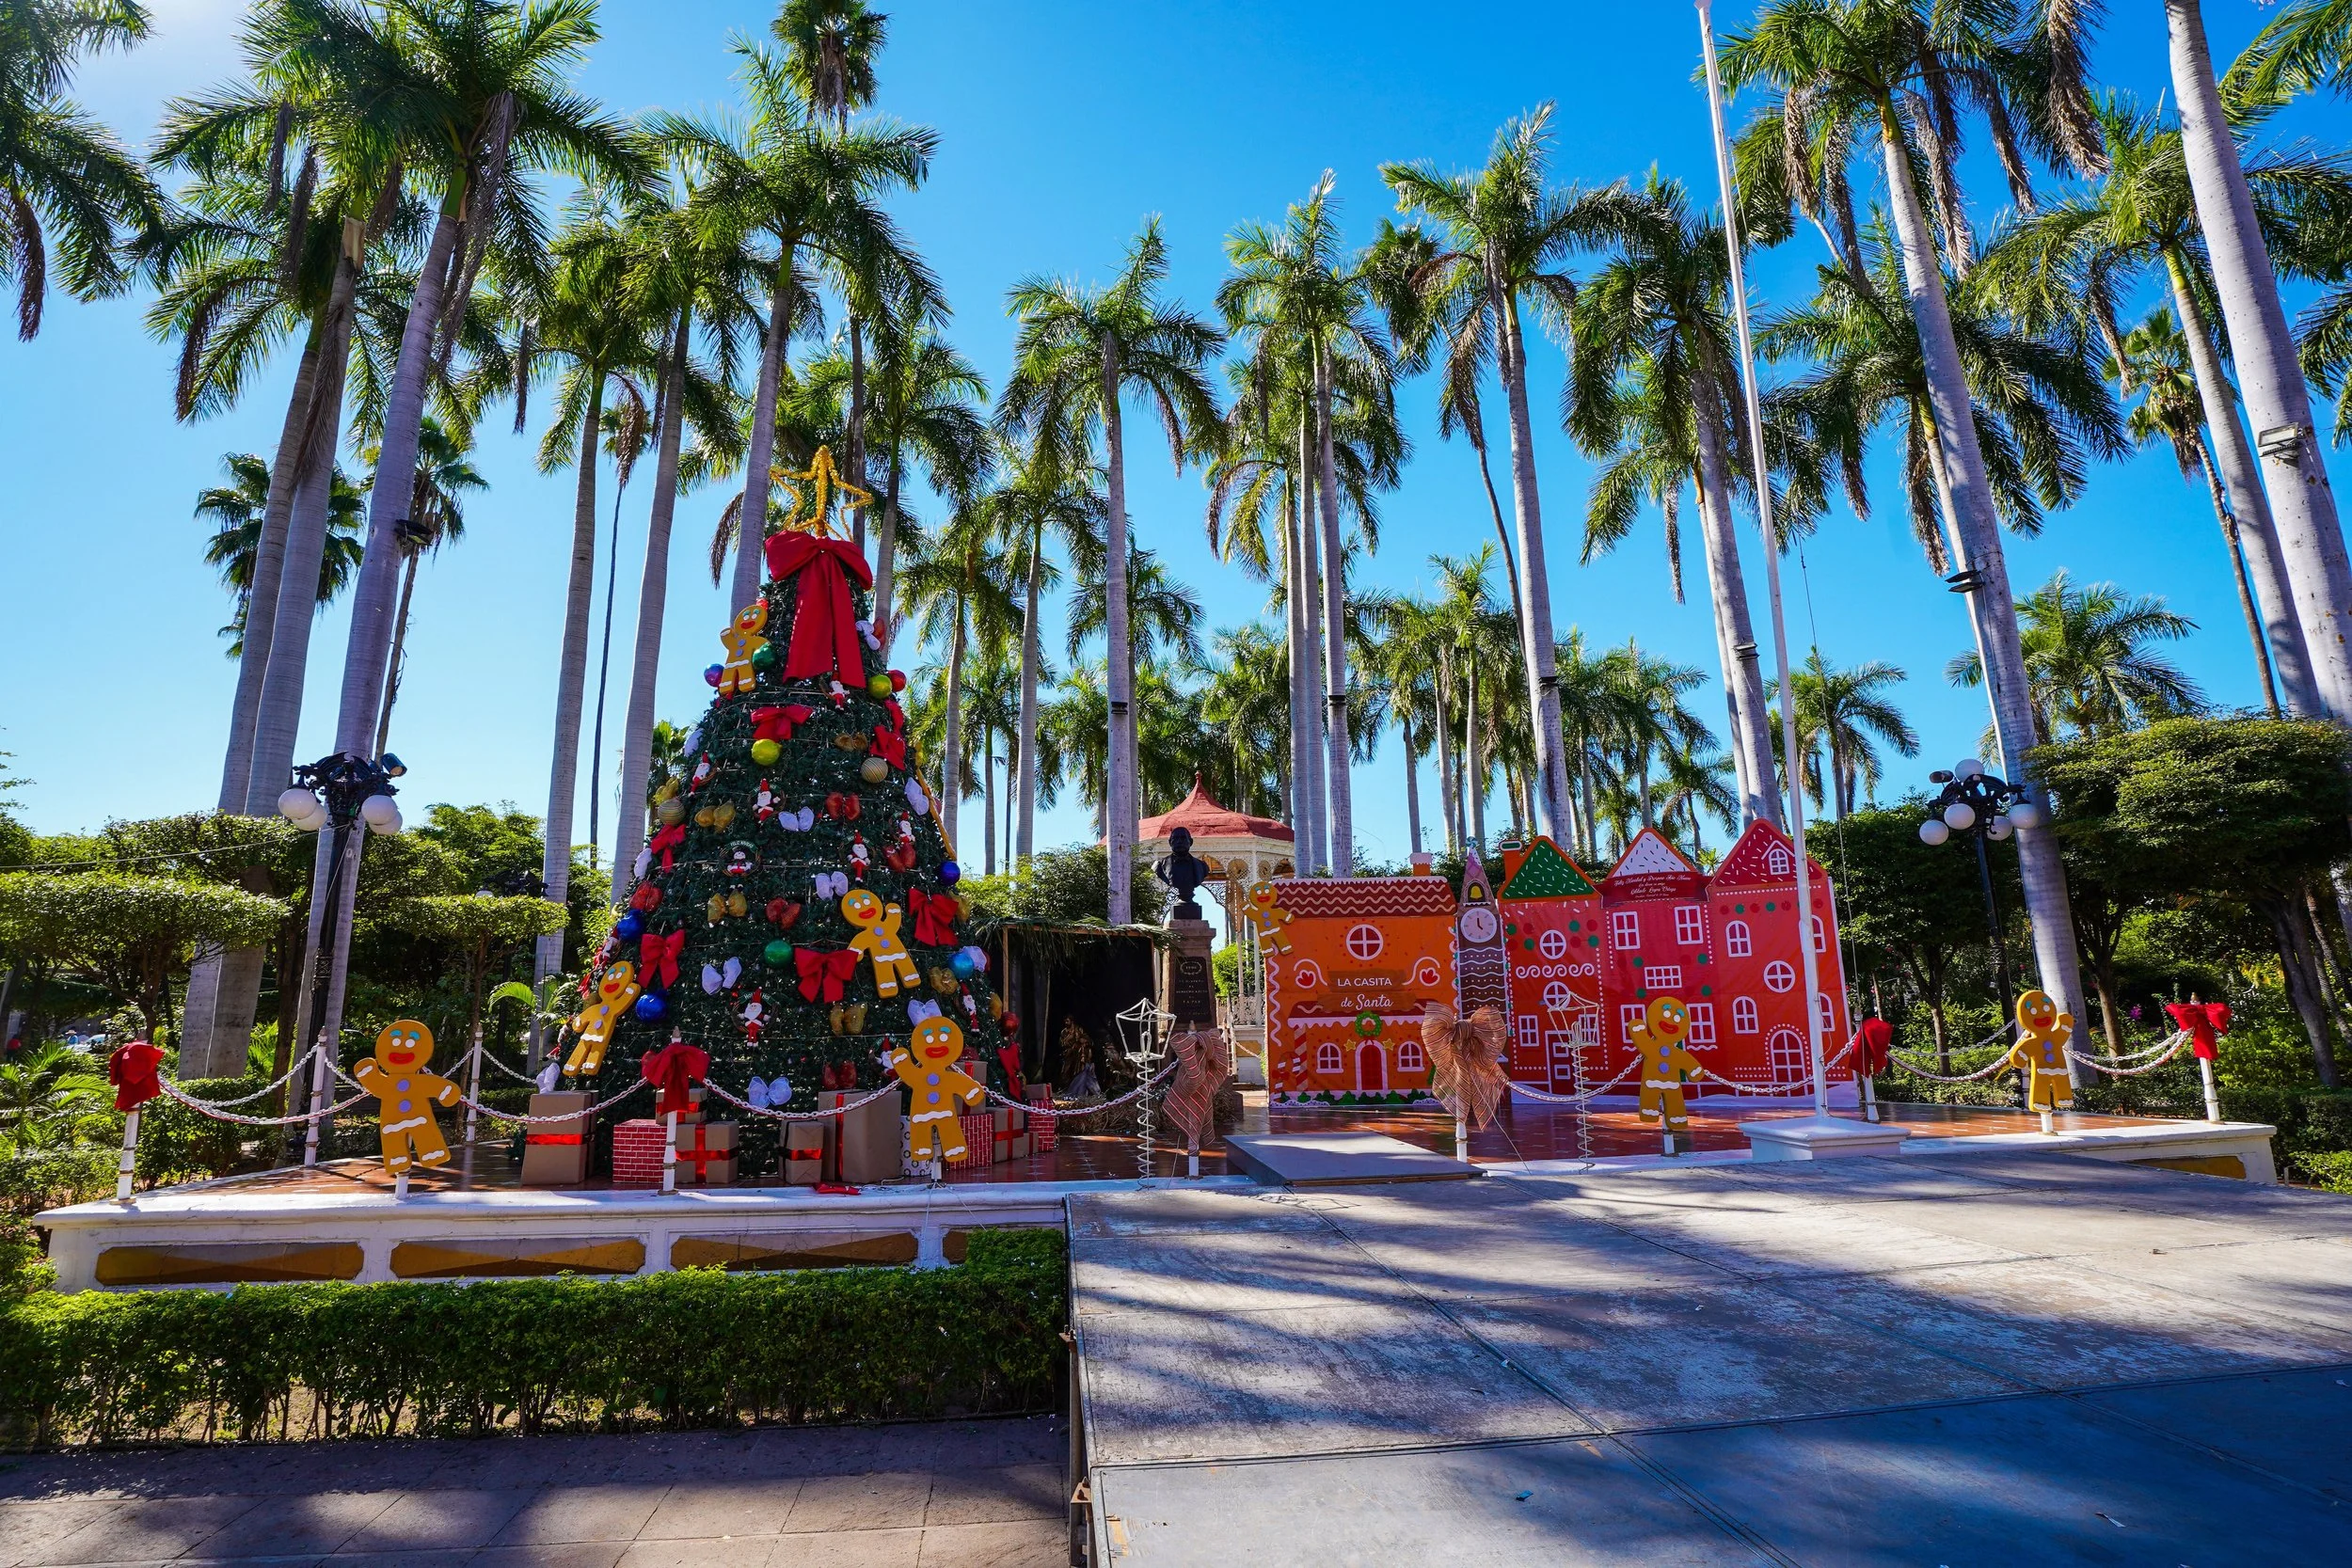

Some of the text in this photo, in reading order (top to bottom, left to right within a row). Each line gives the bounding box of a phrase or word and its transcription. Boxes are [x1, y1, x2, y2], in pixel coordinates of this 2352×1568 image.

[1337, 977, 1392, 987] LA CASITA
[1341, 993, 1393, 1011] de Santa
